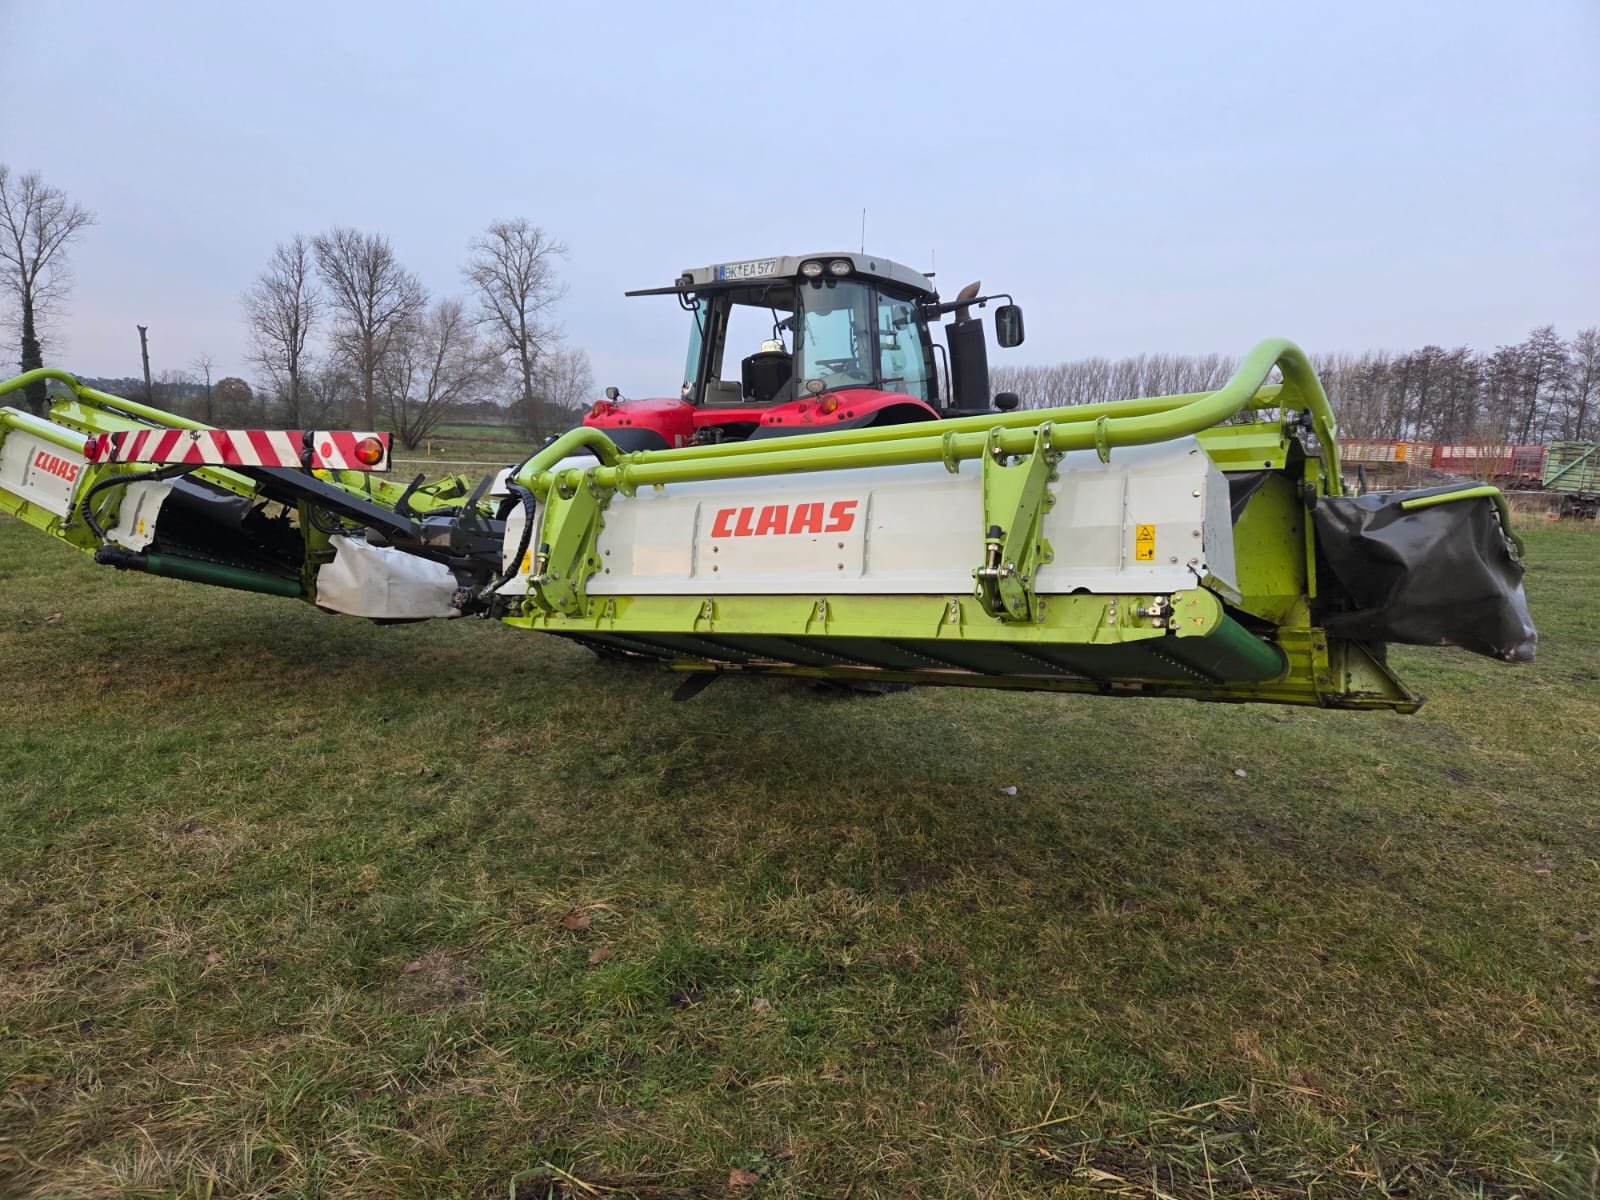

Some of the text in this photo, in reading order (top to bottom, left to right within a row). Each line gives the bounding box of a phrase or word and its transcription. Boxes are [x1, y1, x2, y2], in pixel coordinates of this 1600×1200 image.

[743, 263, 756, 276] EA
[757, 260, 776, 275] 577
[34, 450, 79, 482] CLAAS
[710, 500, 858, 538] CLAAS
